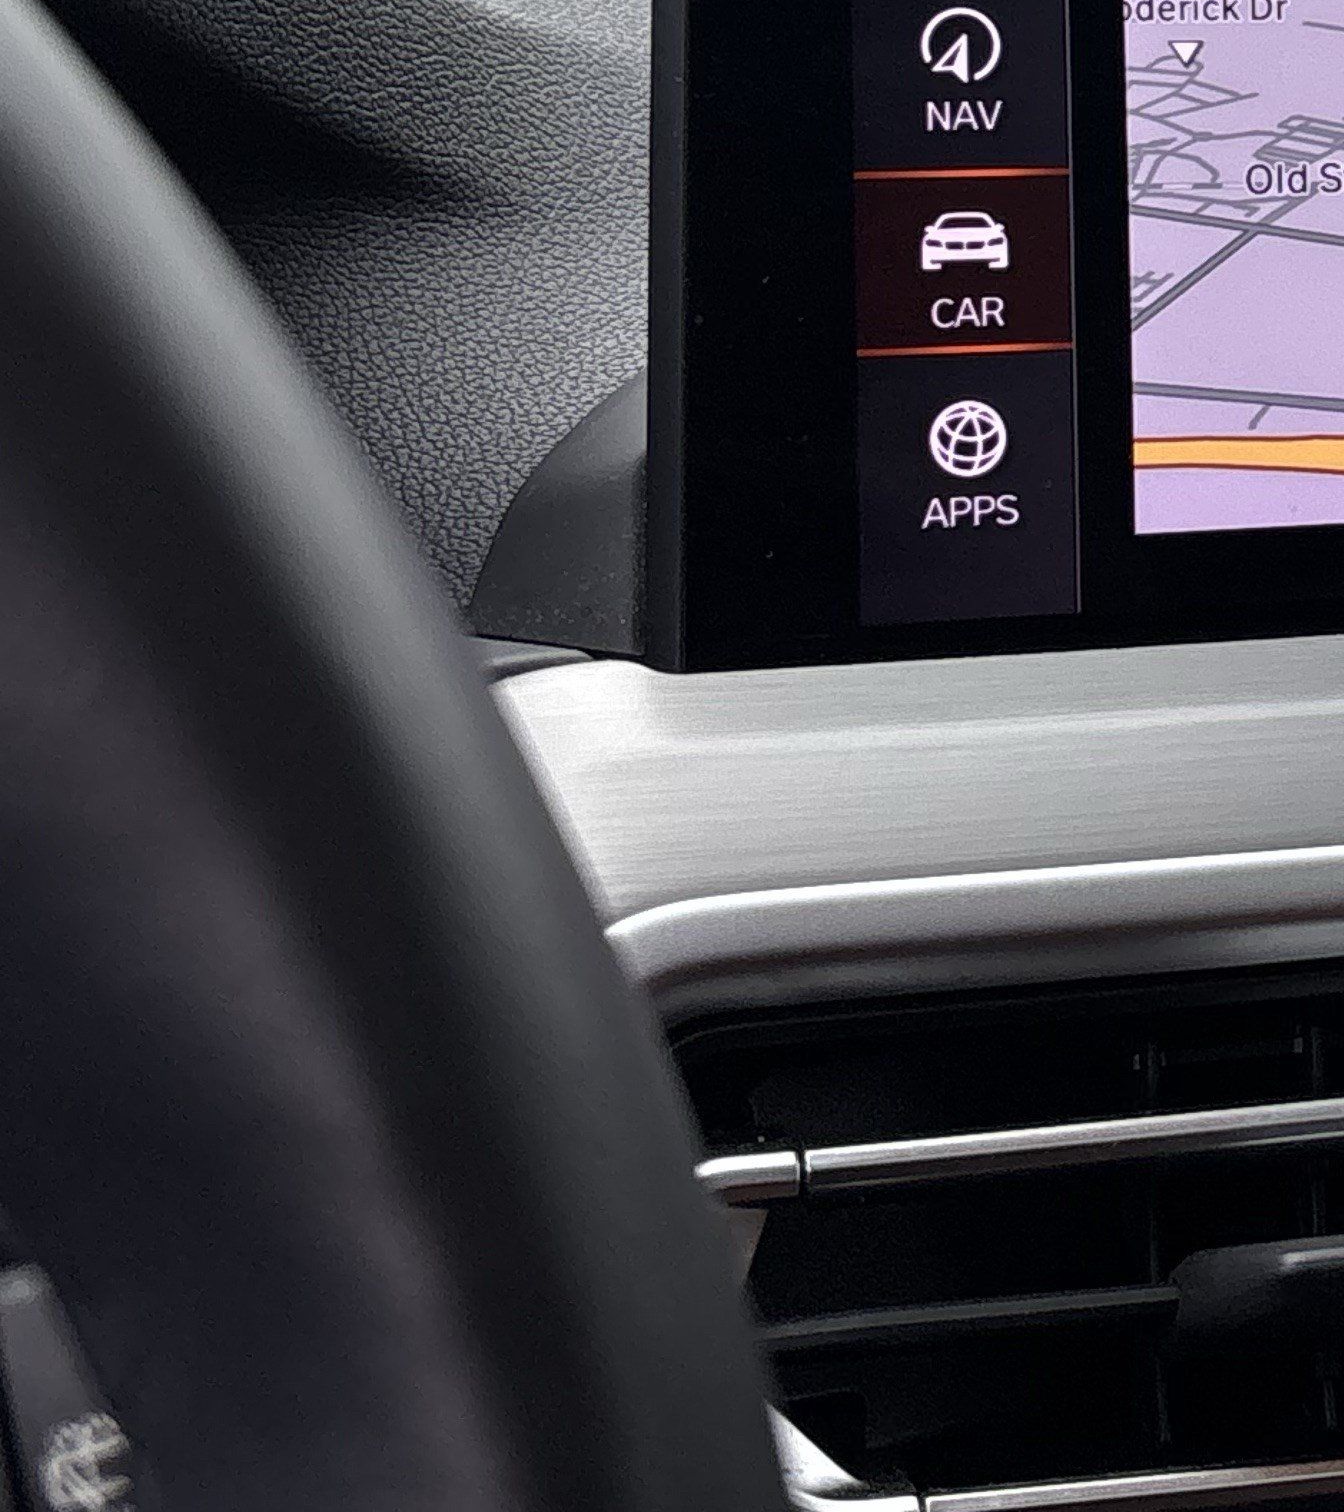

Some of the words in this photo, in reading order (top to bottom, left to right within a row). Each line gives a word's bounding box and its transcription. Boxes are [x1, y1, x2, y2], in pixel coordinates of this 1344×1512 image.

[926, 101, 1002, 132] NAV
[1245, 164, 1307, 194] Old
[930, 297, 1005, 328] CAR
[922, 496, 1019, 529] APPS
